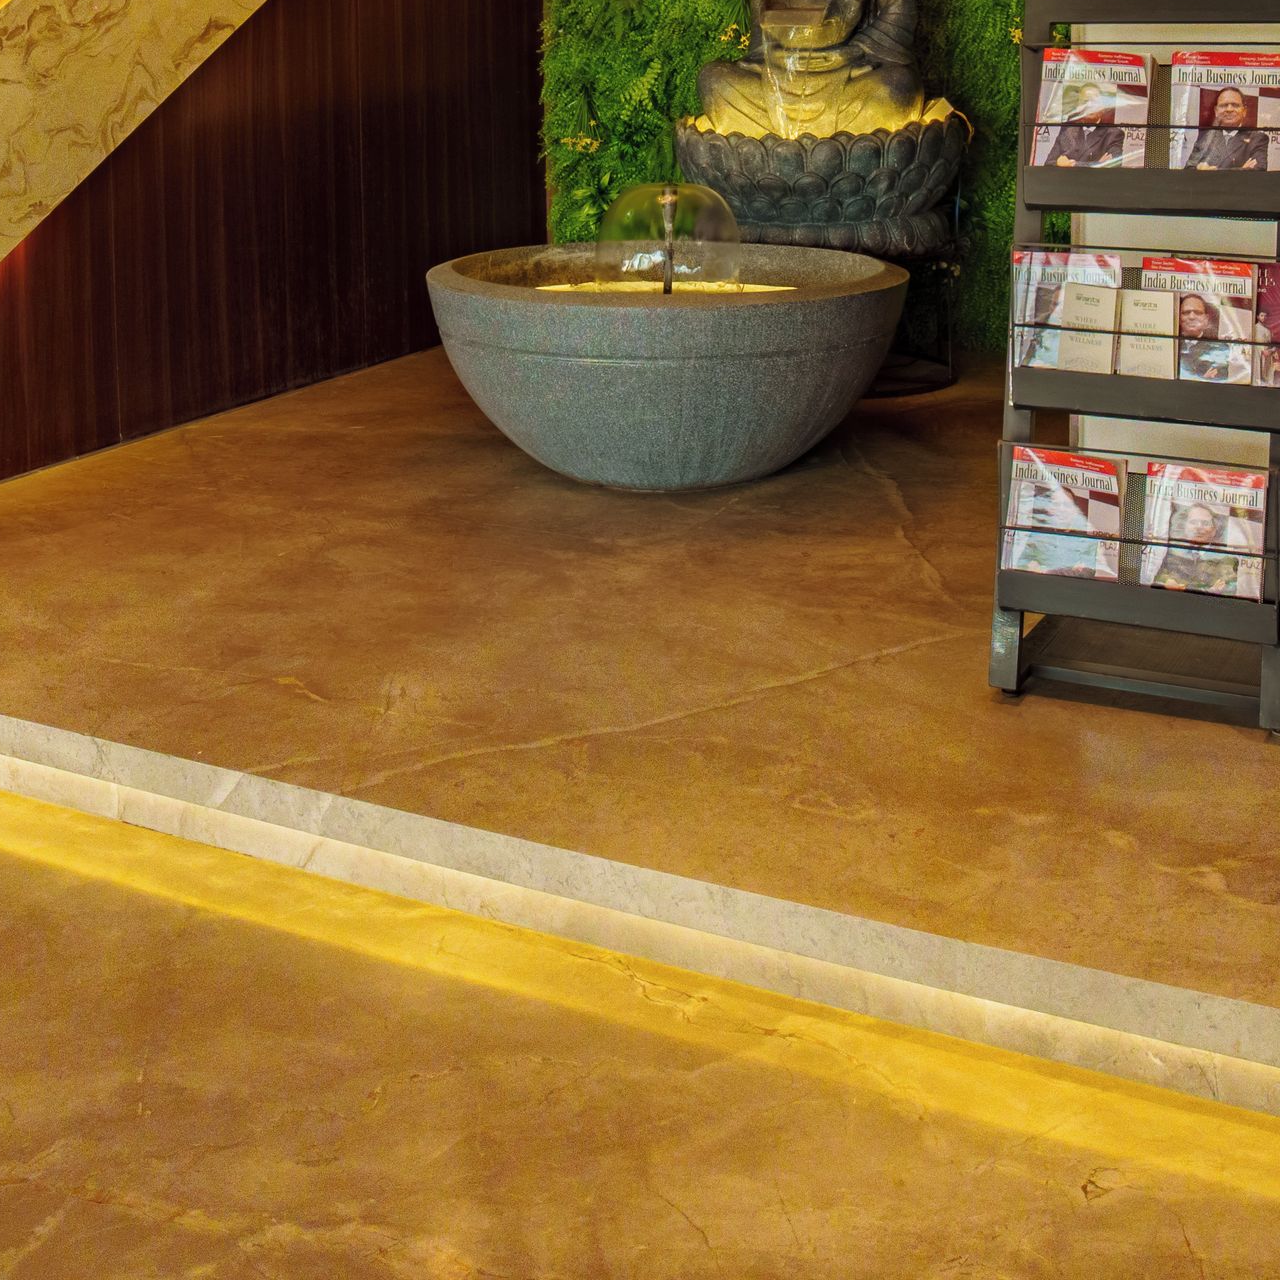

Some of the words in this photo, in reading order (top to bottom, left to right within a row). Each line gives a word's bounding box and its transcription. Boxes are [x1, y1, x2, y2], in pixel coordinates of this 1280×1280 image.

[1044, 63, 1066, 79] India
[1069, 65, 1106, 80] Business
[1109, 67, 1142, 83] Journal
[1178, 67, 1203, 83] India
[1206, 68, 1247, 85] Business
[1143, 271, 1167, 288] India
[1170, 274, 1209, 291] Business
[1212, 278, 1247, 295] Journal
[1015, 463, 1038, 481] India
[1081, 472, 1113, 492] Journal
[1177, 483, 1218, 501] Business
[1221, 488, 1259, 508] Journal
